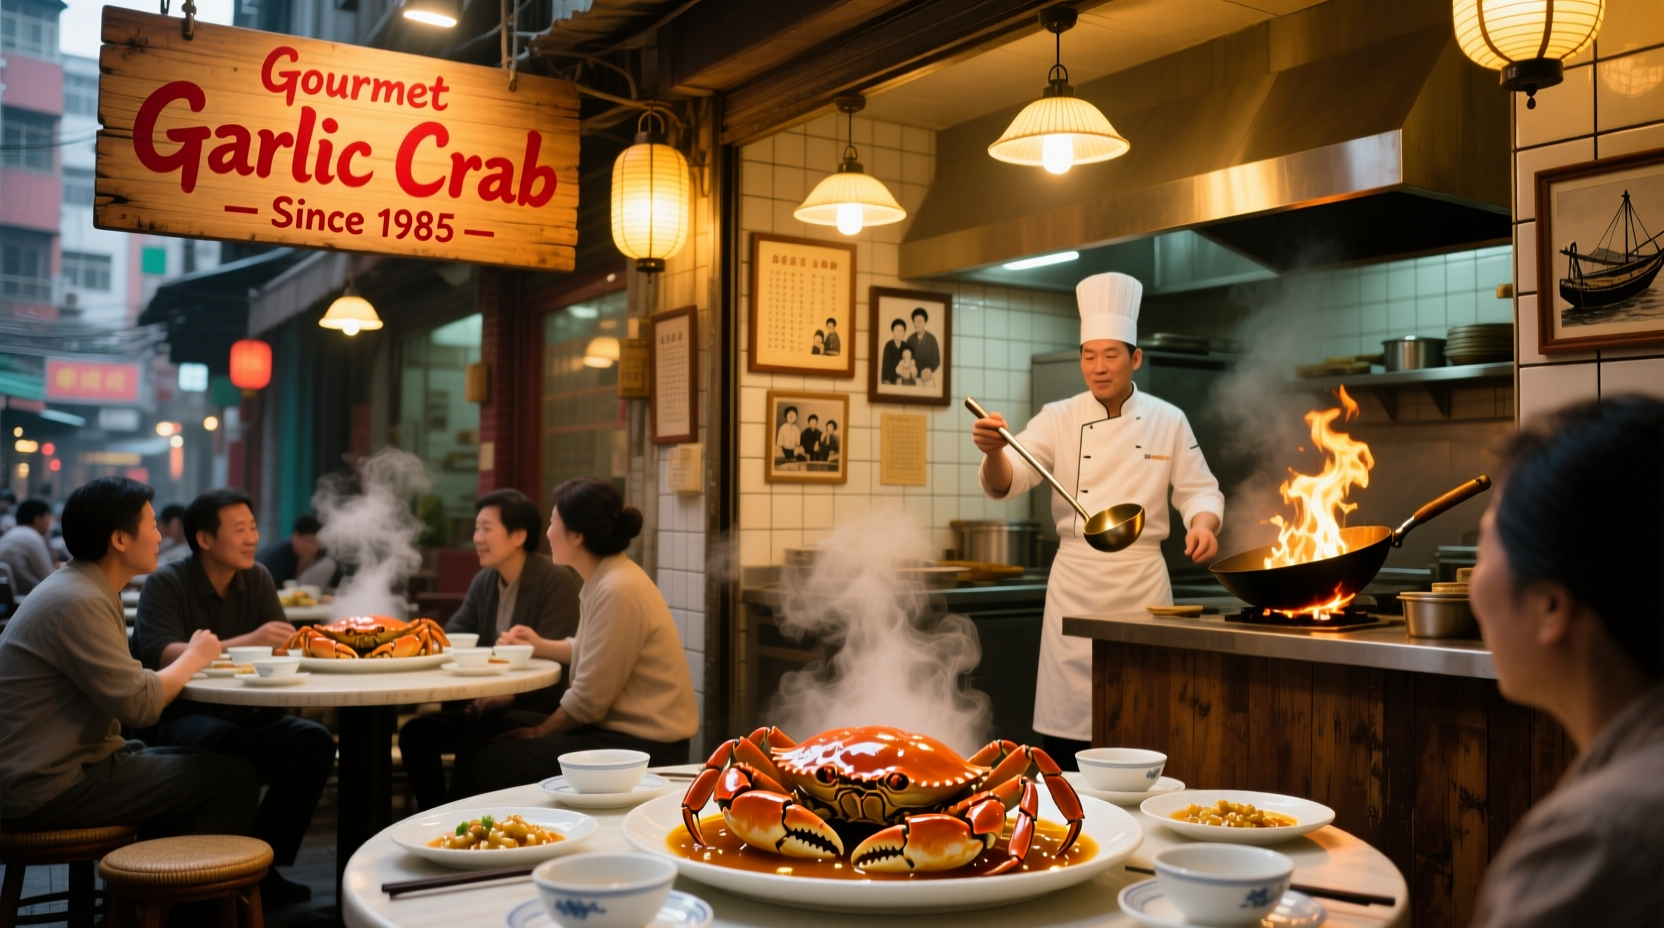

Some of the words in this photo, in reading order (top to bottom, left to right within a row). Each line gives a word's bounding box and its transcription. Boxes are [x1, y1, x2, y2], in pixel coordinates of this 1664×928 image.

[260, 46, 450, 112] Gourmet
[133, 80, 375, 194] Garlic
[395, 121, 559, 209] Crab
[271, 195, 366, 236] Since
[377, 208, 455, 243] 1985
